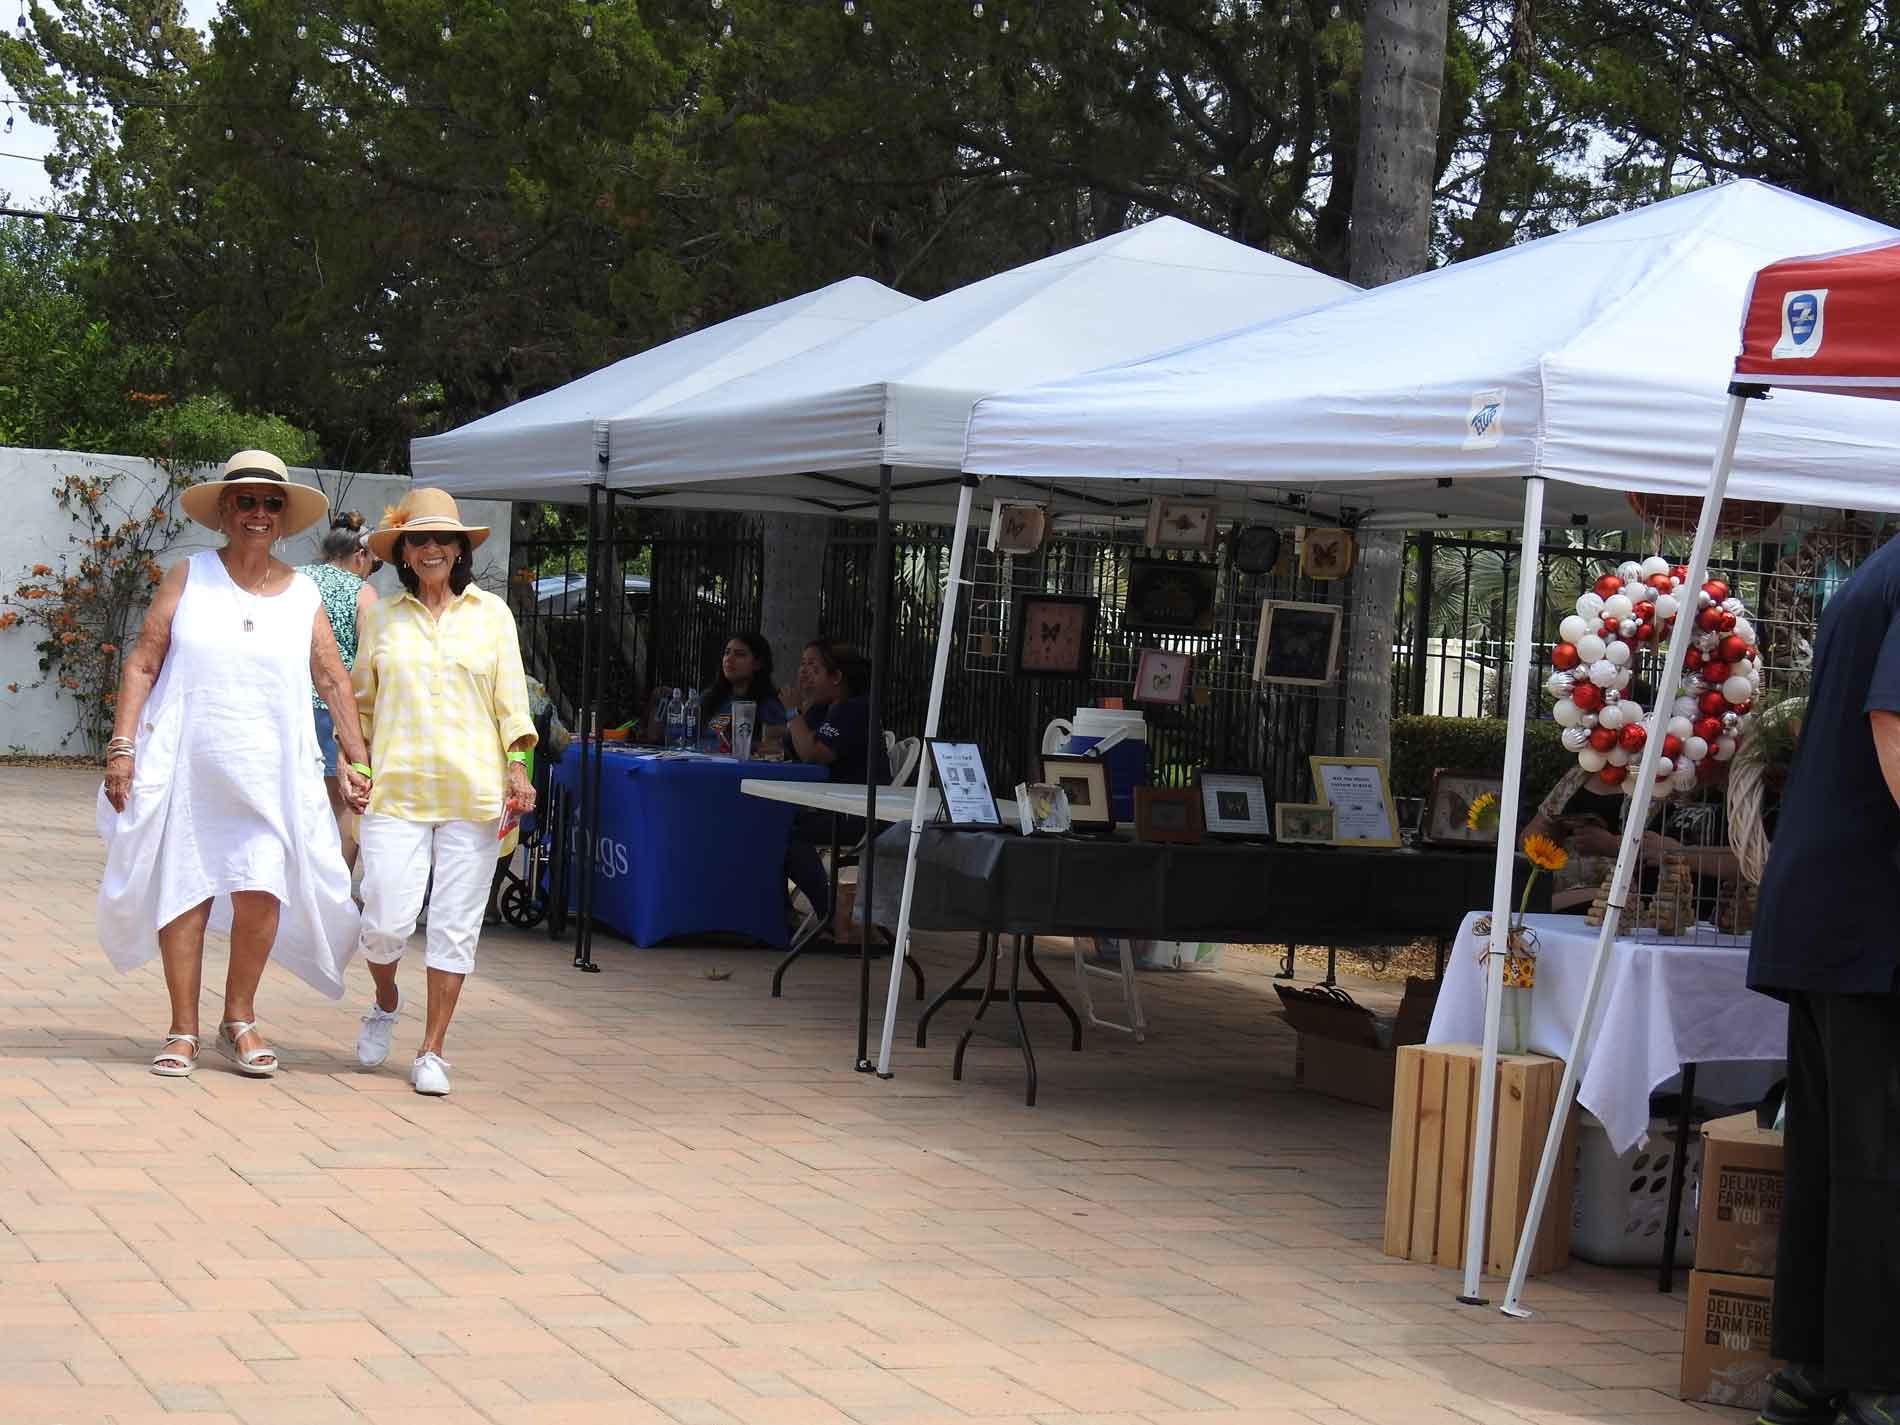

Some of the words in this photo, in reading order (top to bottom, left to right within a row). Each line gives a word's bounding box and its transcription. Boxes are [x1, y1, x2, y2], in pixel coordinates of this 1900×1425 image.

[1719, 1173, 1784, 1195] DELIVERE
[1718, 1190, 1755, 1208] FARM
[1733, 1207, 1761, 1225] YOU
[1707, 1298, 1770, 1321] DELIVERE
[1706, 1313, 1743, 1332] FARM
[1747, 1319, 1770, 1337] FRE
[1720, 1330, 1751, 1351] YOU
